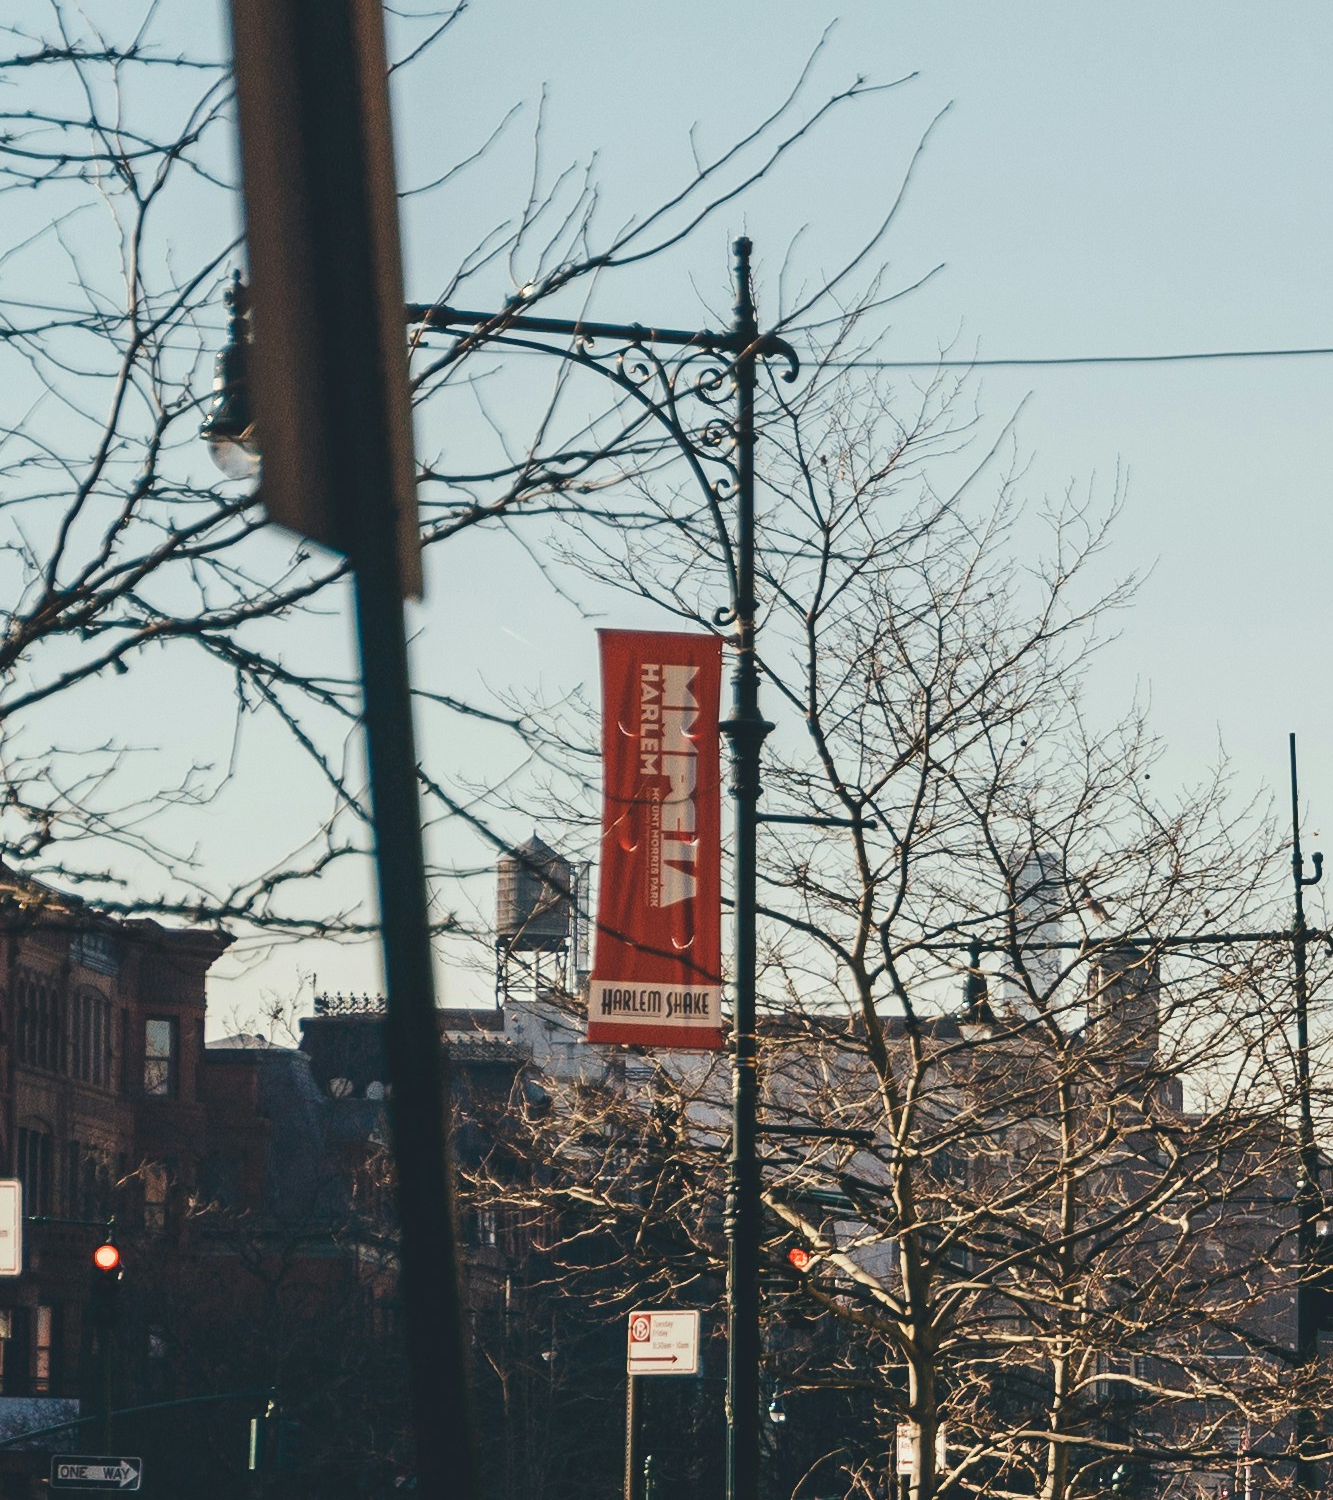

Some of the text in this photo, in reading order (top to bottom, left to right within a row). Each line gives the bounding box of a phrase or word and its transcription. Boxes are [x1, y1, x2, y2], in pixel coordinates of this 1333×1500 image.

[640, 663, 660, 775] HARLEM
[650, 787, 660, 908] MOUNT MORRIS PARK
[601, 987, 710, 1018] HARLEM SHAKE
[60, 1466, 130, 1479] ONE WAY
